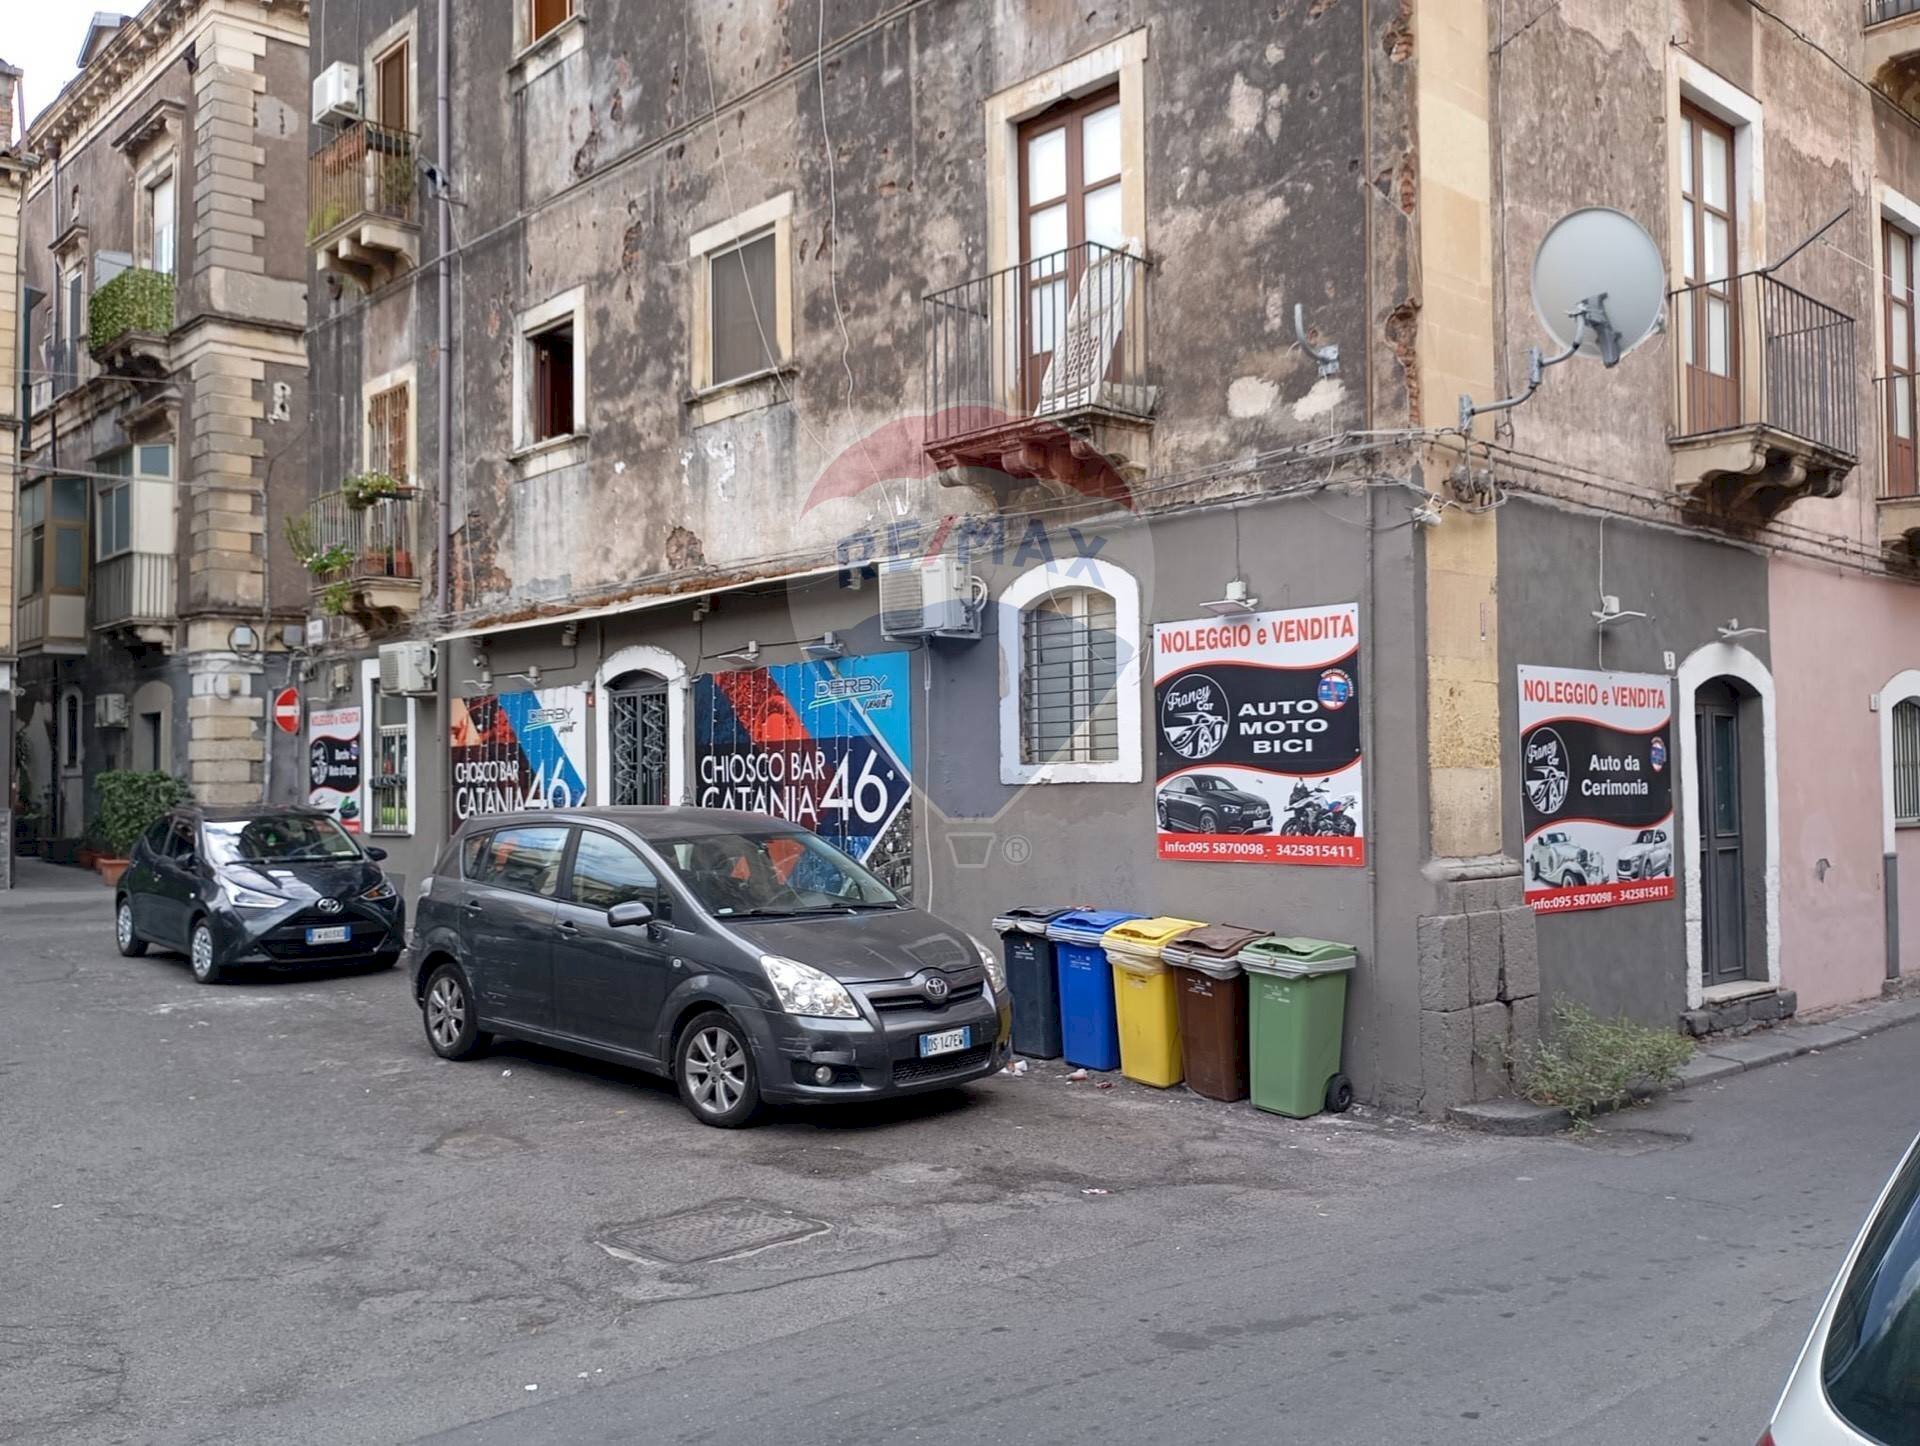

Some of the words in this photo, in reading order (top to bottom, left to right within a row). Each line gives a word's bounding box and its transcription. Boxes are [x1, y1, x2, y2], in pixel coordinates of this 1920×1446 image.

[1161, 624, 1251, 654] NOLEGGIO
[1256, 628, 1267, 645] e
[1272, 614, 1354, 644] VENDITA
[815, 675, 888, 698] DERBY
[1524, 680, 1598, 706] NOLEGGIO
[1602, 690, 1609, 705] e
[1612, 686, 1666, 709] VENDITA
[527, 707, 574, 724] DERBY
[1196, 700, 1214, 711] Car
[1238, 700, 1319, 717] AUTO
[1239, 718, 1329, 735] MOTO
[1253, 739, 1313, 754] BICI
[455, 761, 499, 783] CHIOSCO
[500, 760, 520, 781] BAR
[700, 753, 785, 784] CHIOSCO
[791, 751, 826, 781] BAR
[1589, 754, 1620, 771] Auto
[1624, 755, 1640, 770] da
[524, 756, 571, 809] 46
[1581, 779, 1649, 796] Cerimonia
[456, 786, 526, 819] CATANIA
[702, 785, 818, 823] CATANIA
[1213, 843, 1264, 855] 5870098
[1276, 844, 1354, 858] 3425815411
[1573, 892, 1612, 906] 5870098
[1620, 886, 1668, 901] 3425815411
